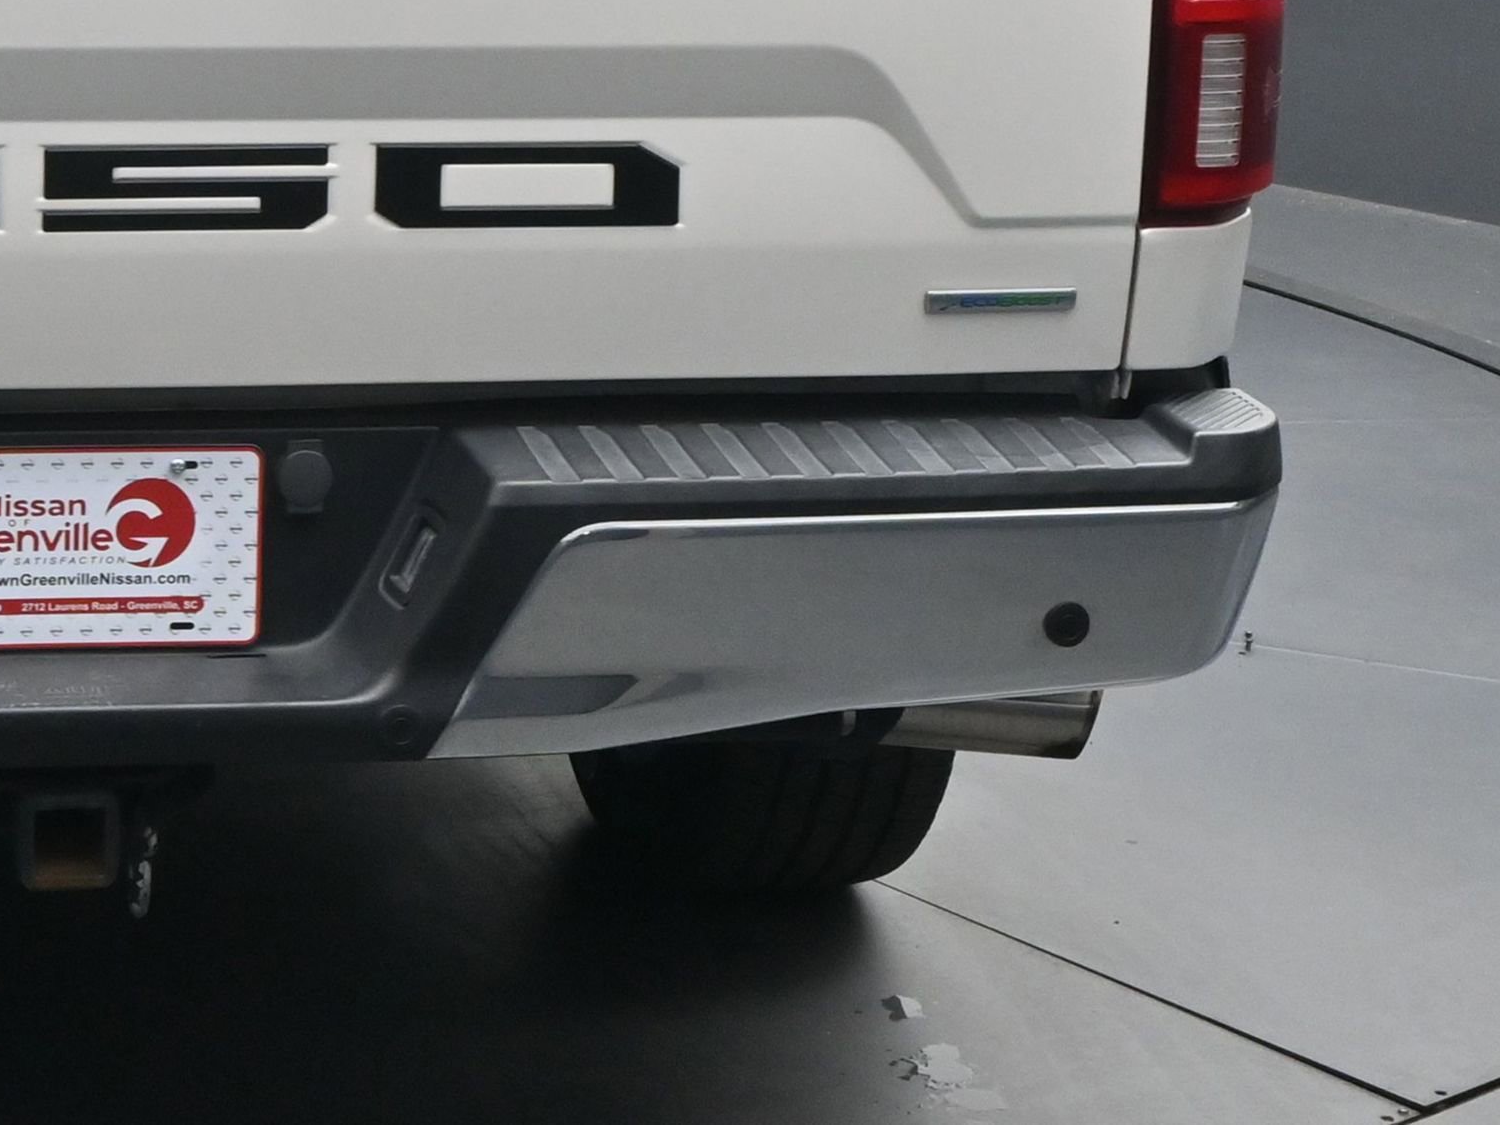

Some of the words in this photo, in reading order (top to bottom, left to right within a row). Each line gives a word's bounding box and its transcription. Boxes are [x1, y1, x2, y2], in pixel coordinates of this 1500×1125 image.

[7, 518, 32, 528] OF
[13, 555, 127, 567] SATISFACTION
[21, 602, 46, 612] 2712
[47, 601, 89, 612] Laurens
[91, 600, 119, 611] Road
[183, 600, 199, 610] SC
